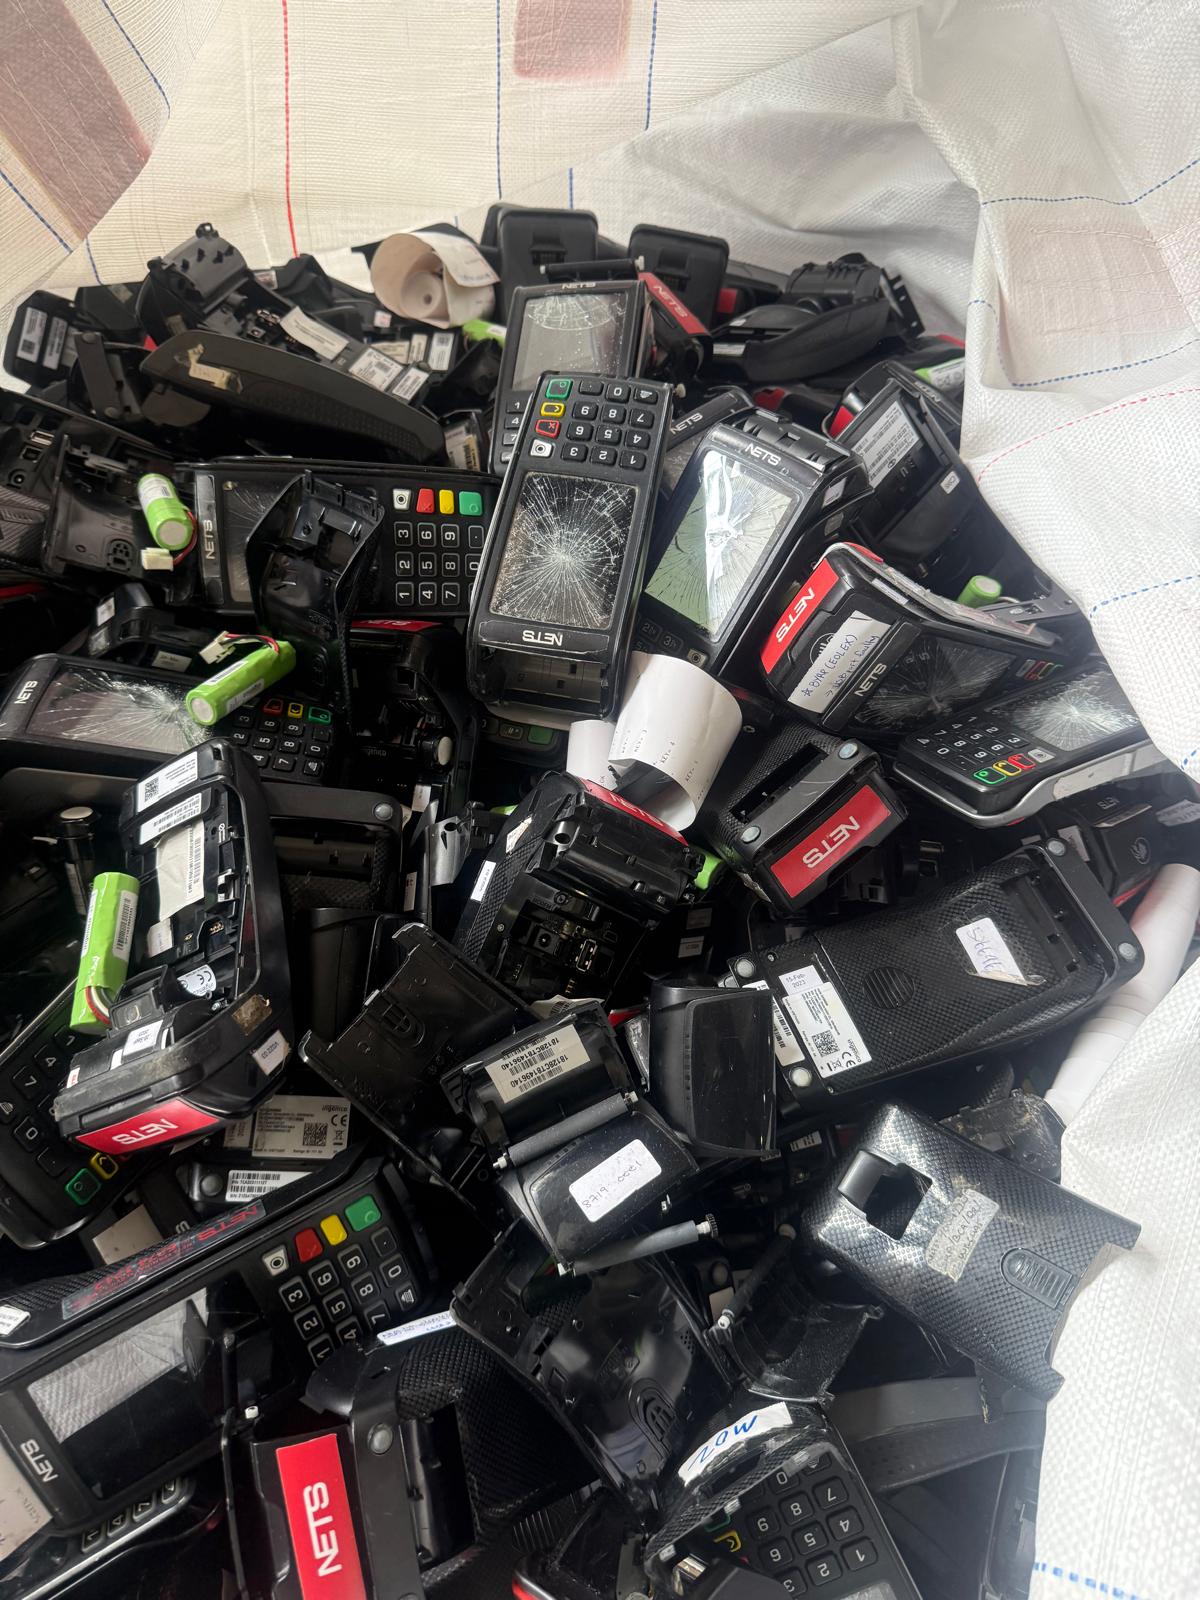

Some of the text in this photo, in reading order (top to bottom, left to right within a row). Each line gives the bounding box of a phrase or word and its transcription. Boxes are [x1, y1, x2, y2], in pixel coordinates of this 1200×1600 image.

[561, 282, 596, 290] NETS
[653, 284, 688, 318] NETS
[670, 412, 703, 435] NETS
[745, 442, 782, 466] NETS
[203, 519, 215, 560] NETS
[775, 587, 815, 643] NETS
[521, 630, 564, 646] NETS
[15, 679, 39, 705] NETS
[854, 663, 887, 697] NETS
[801, 814, 862, 871] NETS
[111, 1118, 179, 1145] NETS
[196, 1205, 258, 1242] NETS
[20, 1438, 59, 1482] NETS
[303, 1481, 342, 1577] NETS
